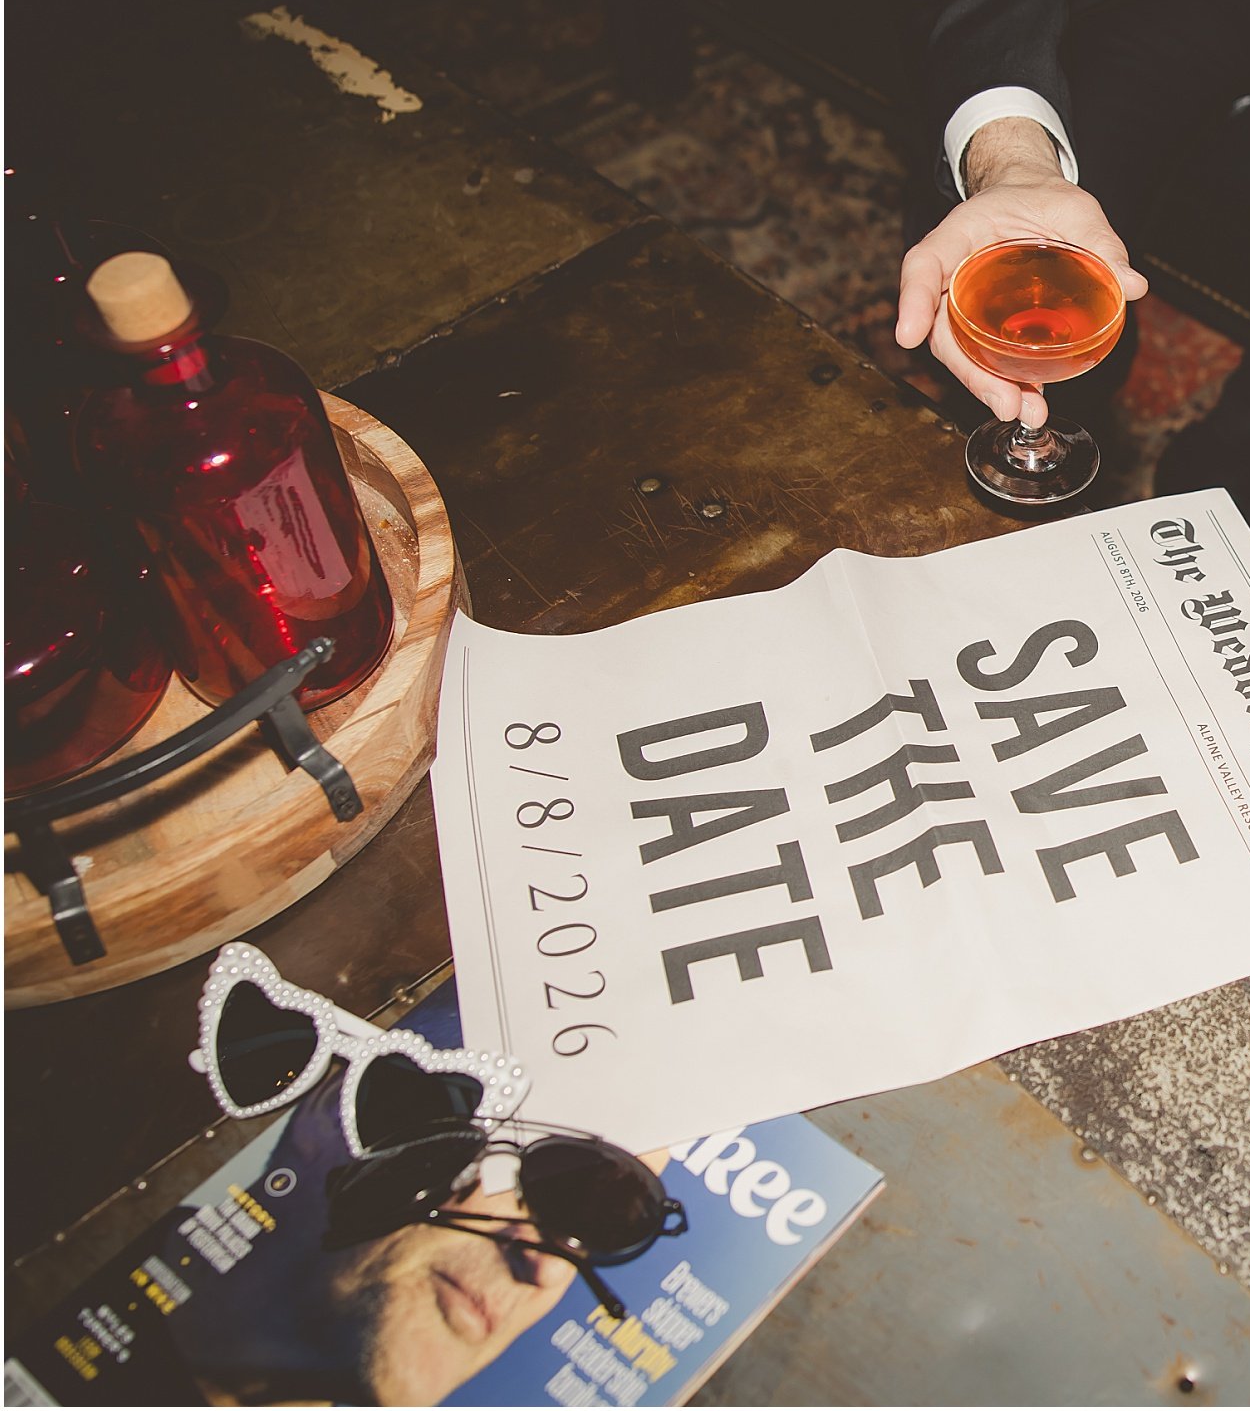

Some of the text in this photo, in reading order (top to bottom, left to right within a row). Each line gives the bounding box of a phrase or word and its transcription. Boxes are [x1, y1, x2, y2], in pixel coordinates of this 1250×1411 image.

[1100, 531, 1149, 613] AUGUST 8TH, 2026
[1148, 517, 1206, 584] The
[810, 680, 1005, 920] THE
[957, 619, 1199, 903] SAVE
[1197, 723, 1223, 762] ALPINE
[1218, 763, 1244, 801] VALLEY
[503, 721, 619, 1058] 8/8/2026
[617, 702, 832, 1004] DATE
[641, 1296, 705, 1352] skipper
[660, 1260, 731, 1327] Brewers
[609, 1315, 678, 1383] Murphy
